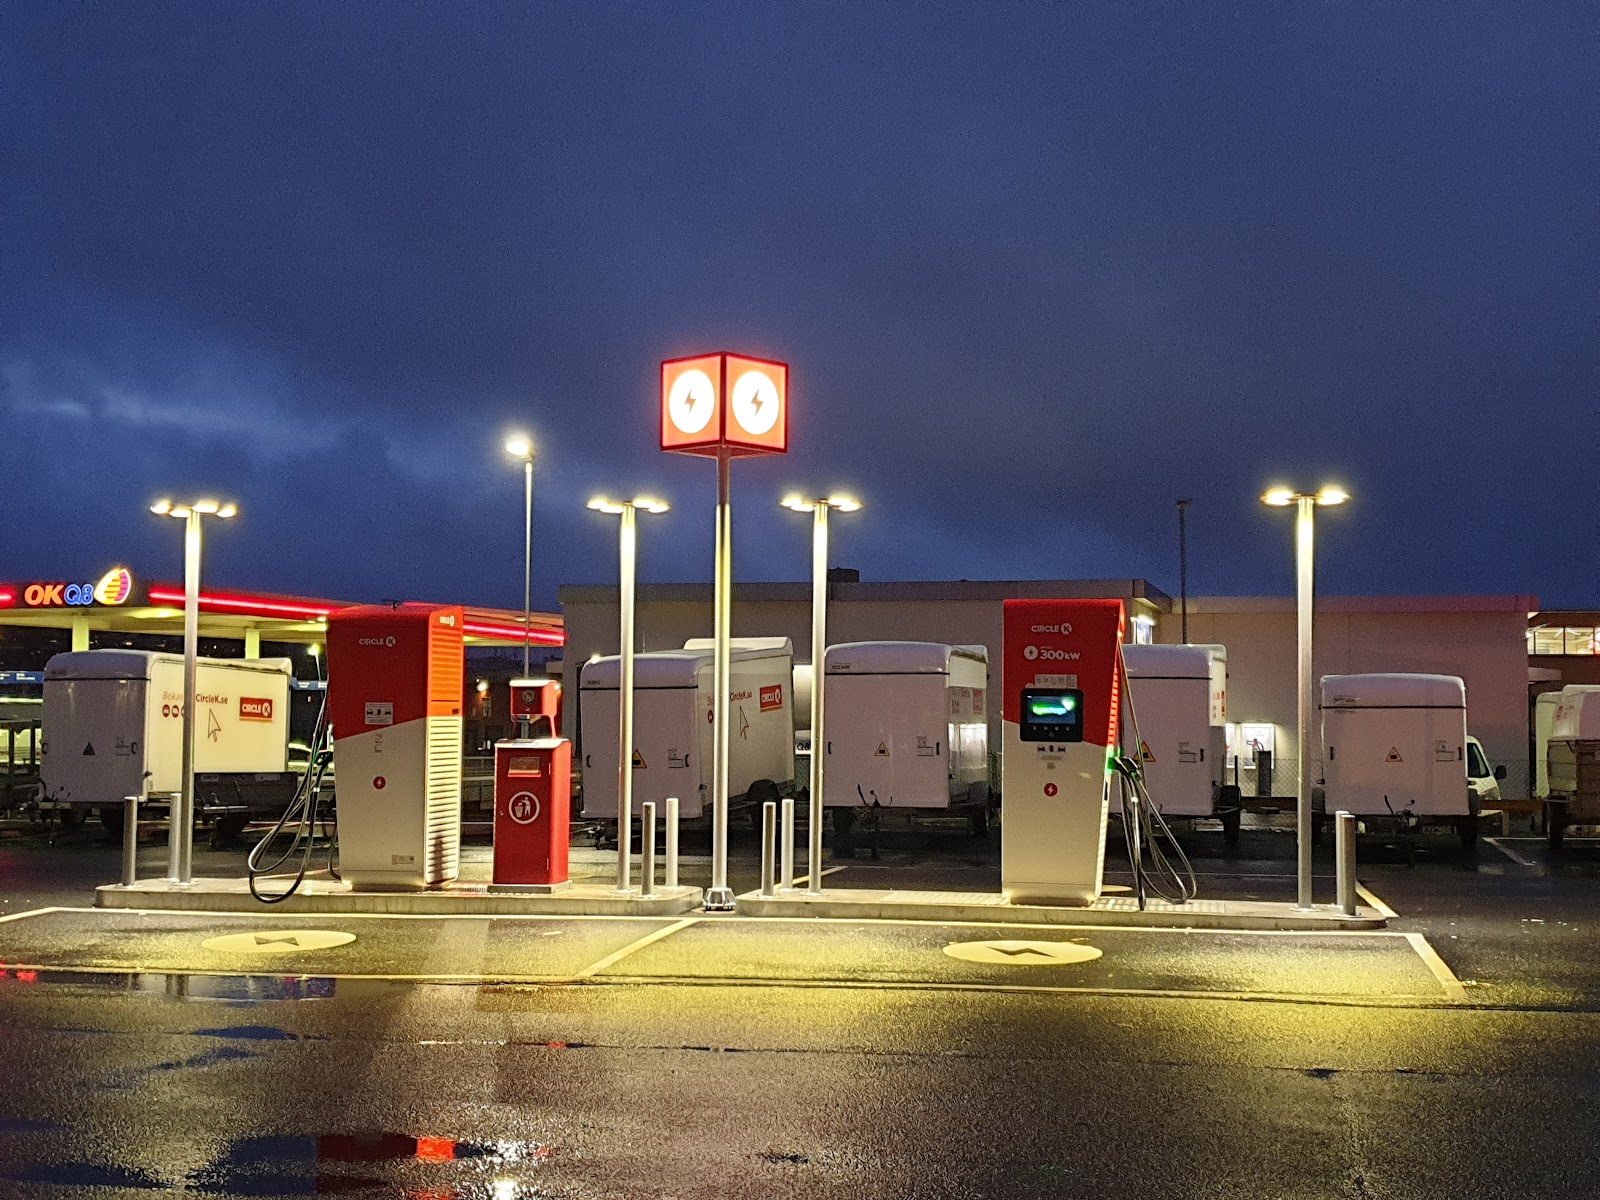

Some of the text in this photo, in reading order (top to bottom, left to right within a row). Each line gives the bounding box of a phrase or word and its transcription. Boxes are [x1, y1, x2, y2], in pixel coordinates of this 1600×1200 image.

[1031, 623, 1072, 635] CIRCLE K
[358, 636, 396, 648] CIRCLE K
[195, 693, 228, 705] CircleK.se
[241, 702, 271, 717] CIRCLE K
